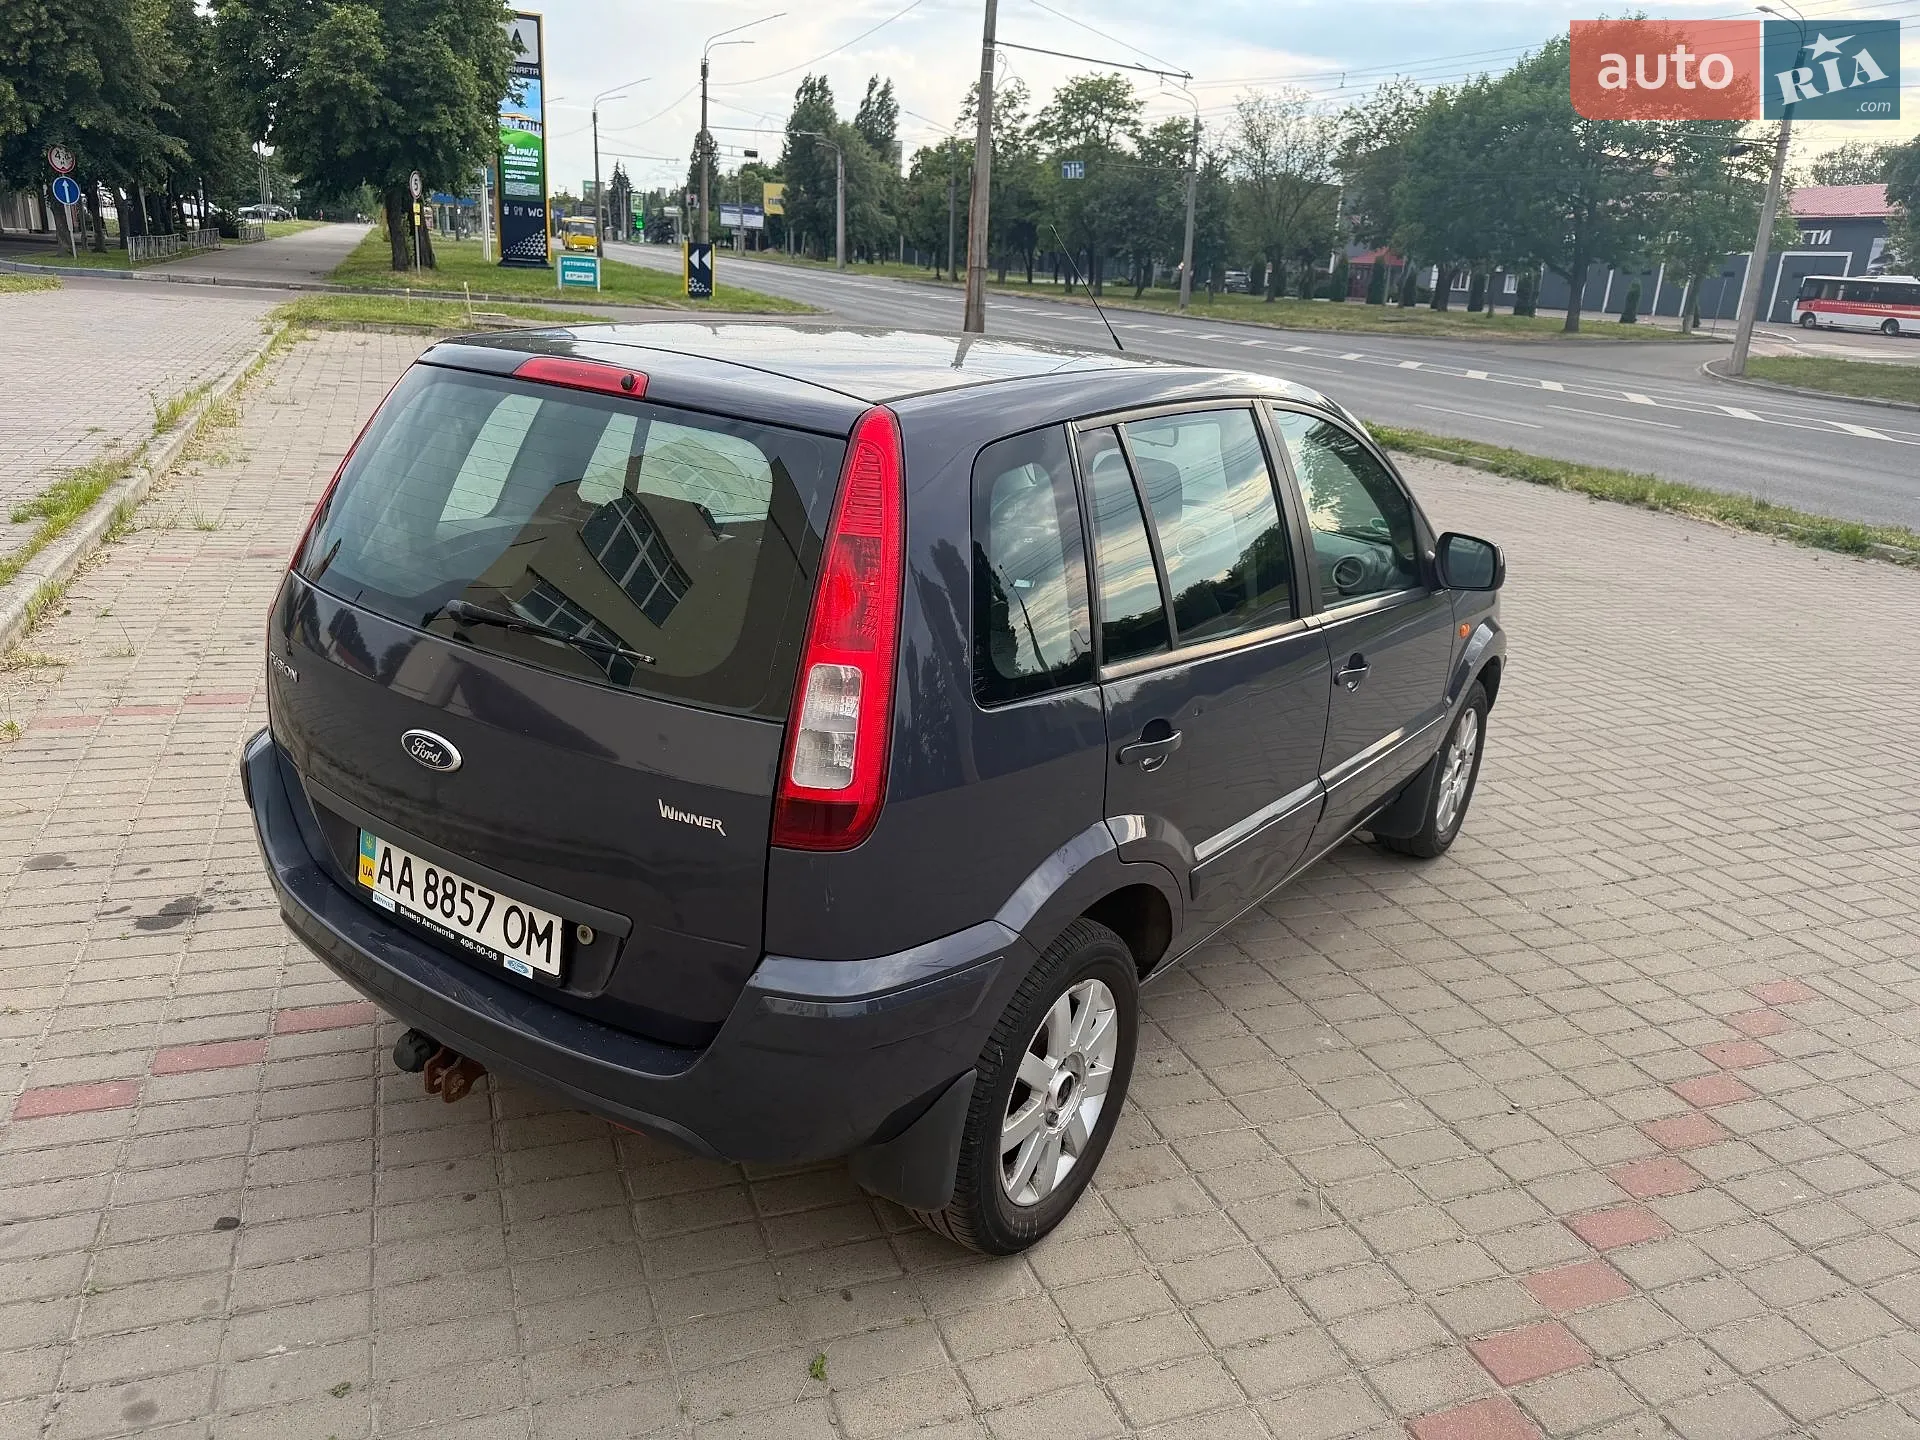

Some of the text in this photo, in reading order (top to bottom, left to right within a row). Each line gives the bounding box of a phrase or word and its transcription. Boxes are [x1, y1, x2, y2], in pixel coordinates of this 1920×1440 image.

[528, 207, 544, 217] WC
[411, 737, 442, 765] Ford
[658, 798, 727, 837] WINNER
[362, 863, 374, 880] UA
[377, 846, 554, 964] AA 8857 OM
[400, 906, 497, 960] Віннер Автомотів 496-00-06
